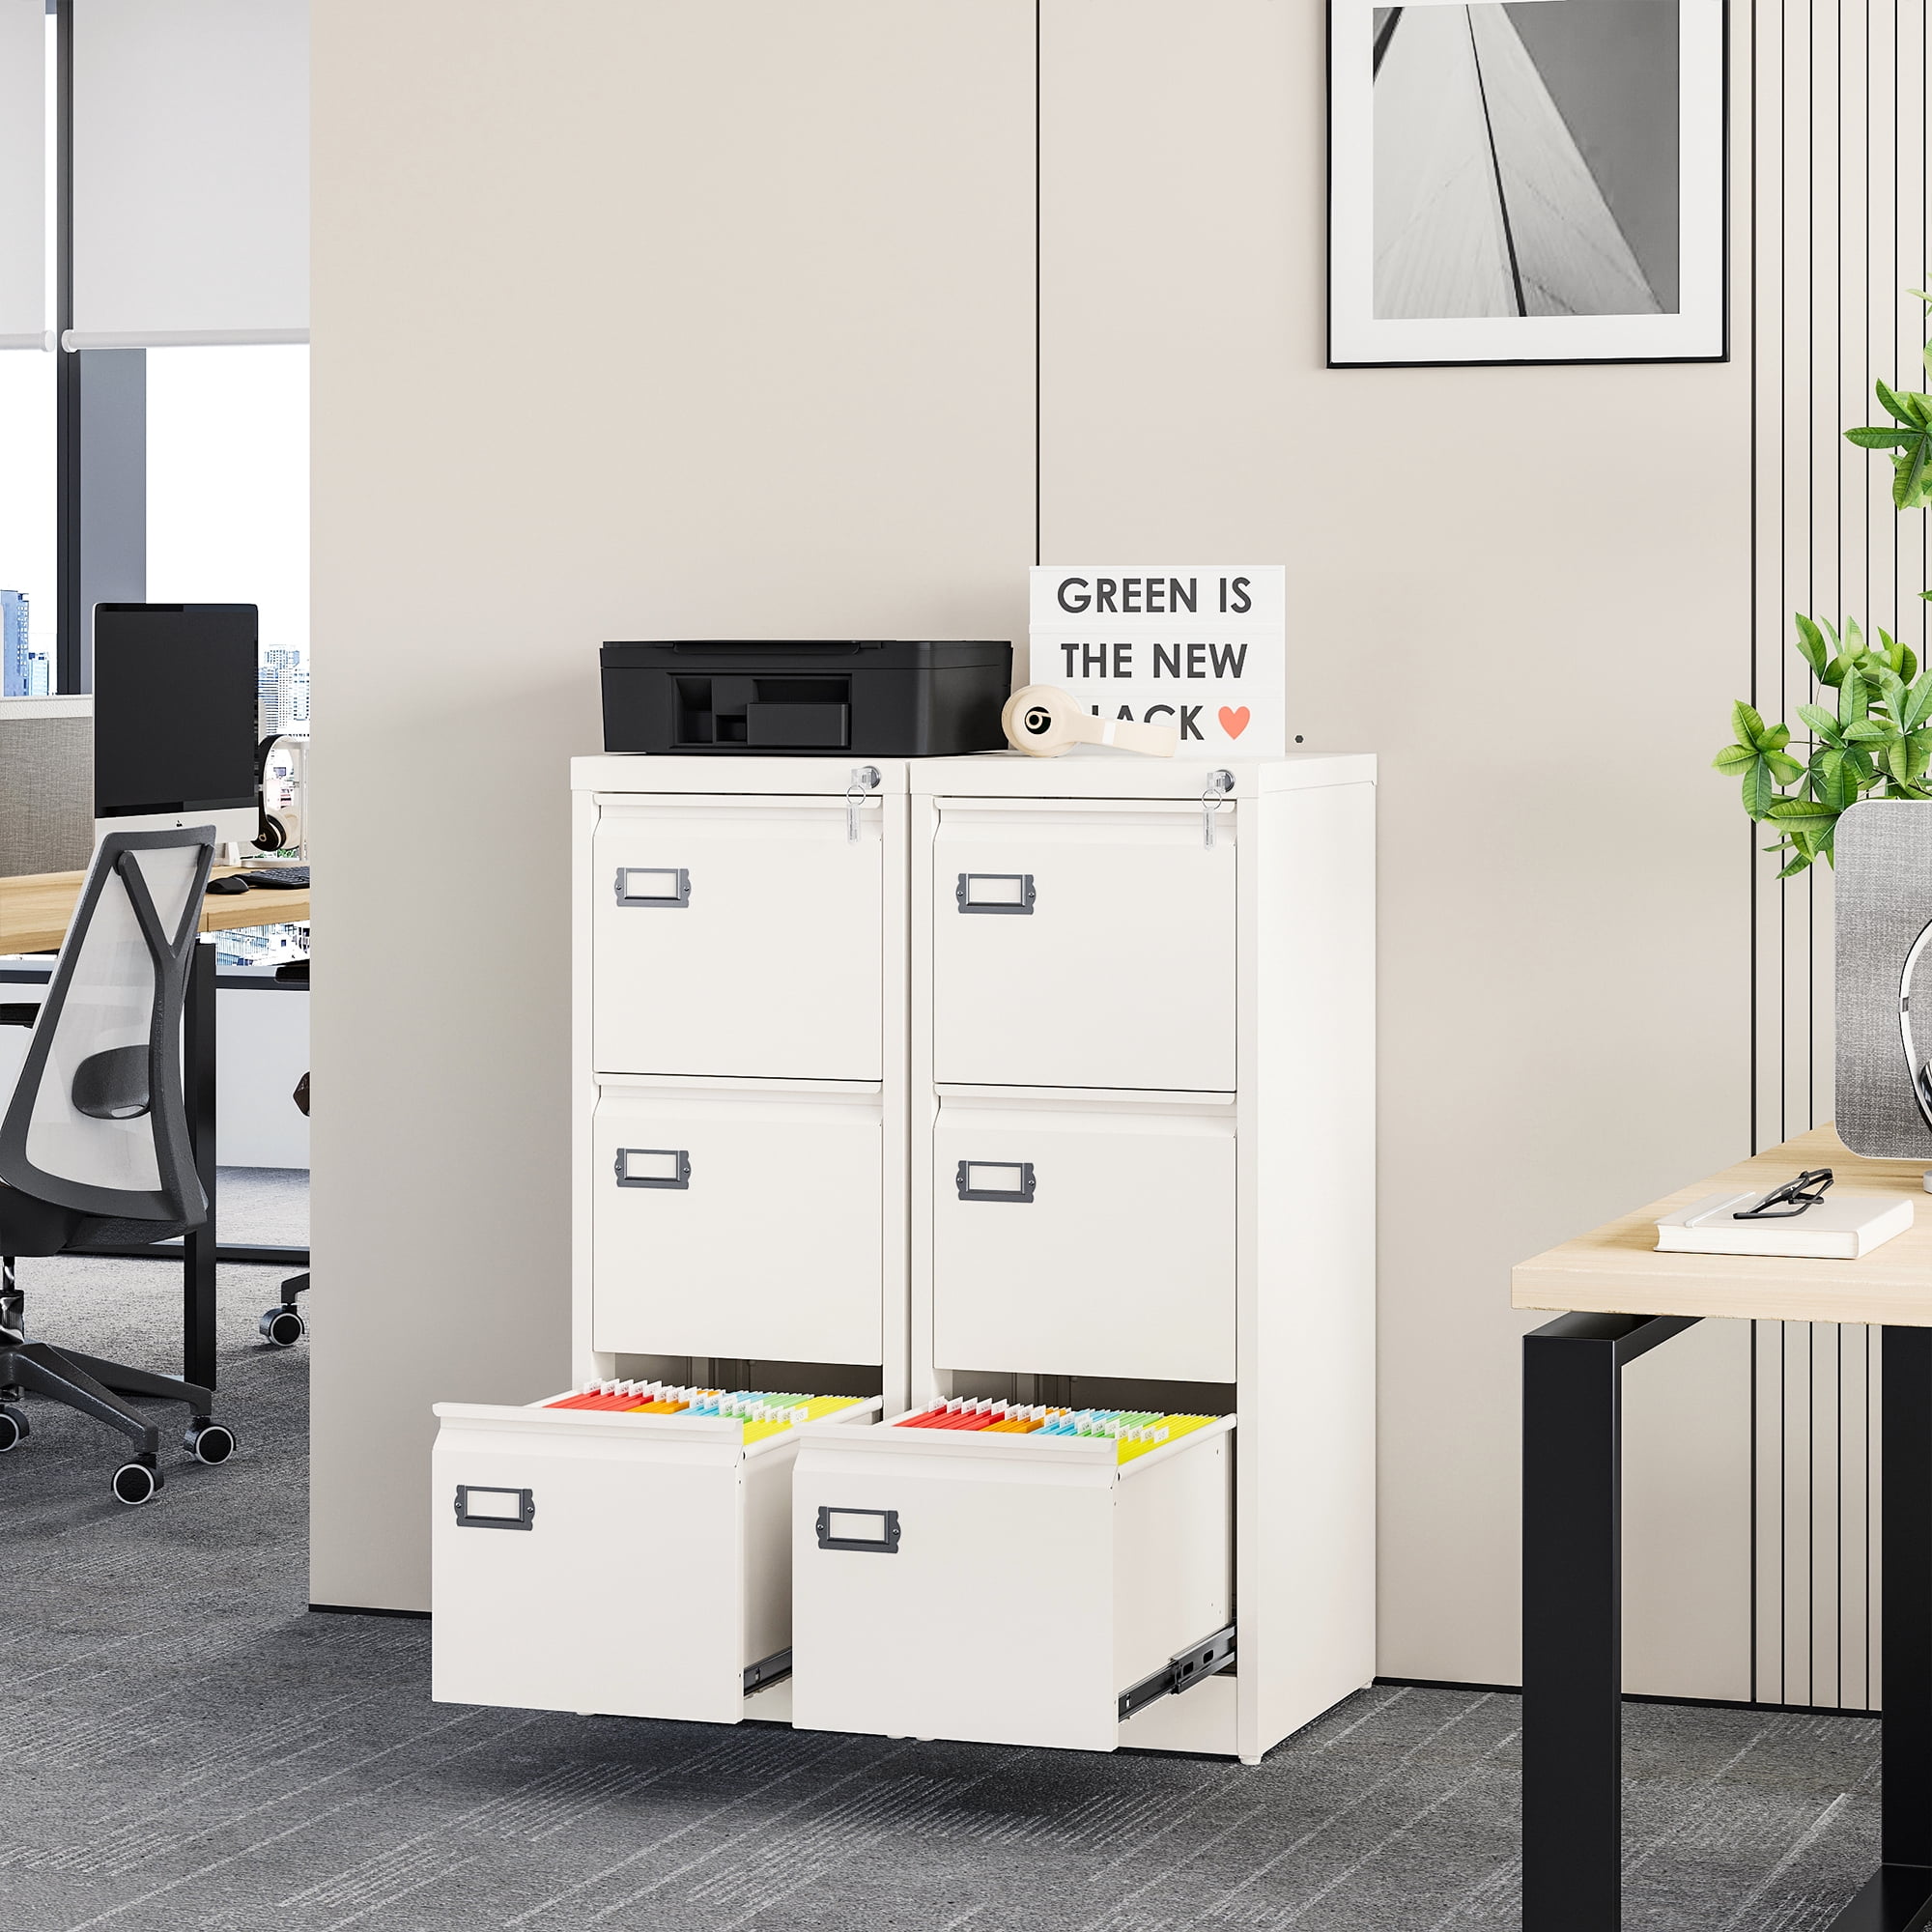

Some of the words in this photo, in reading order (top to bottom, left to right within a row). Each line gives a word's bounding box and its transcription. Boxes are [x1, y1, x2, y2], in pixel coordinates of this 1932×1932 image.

[1057, 577, 1198, 613] GREEN
[1219, 577, 1252, 613] IS
[1060, 642, 1132, 678] THE
[1152, 642, 1248, 678] NEW
